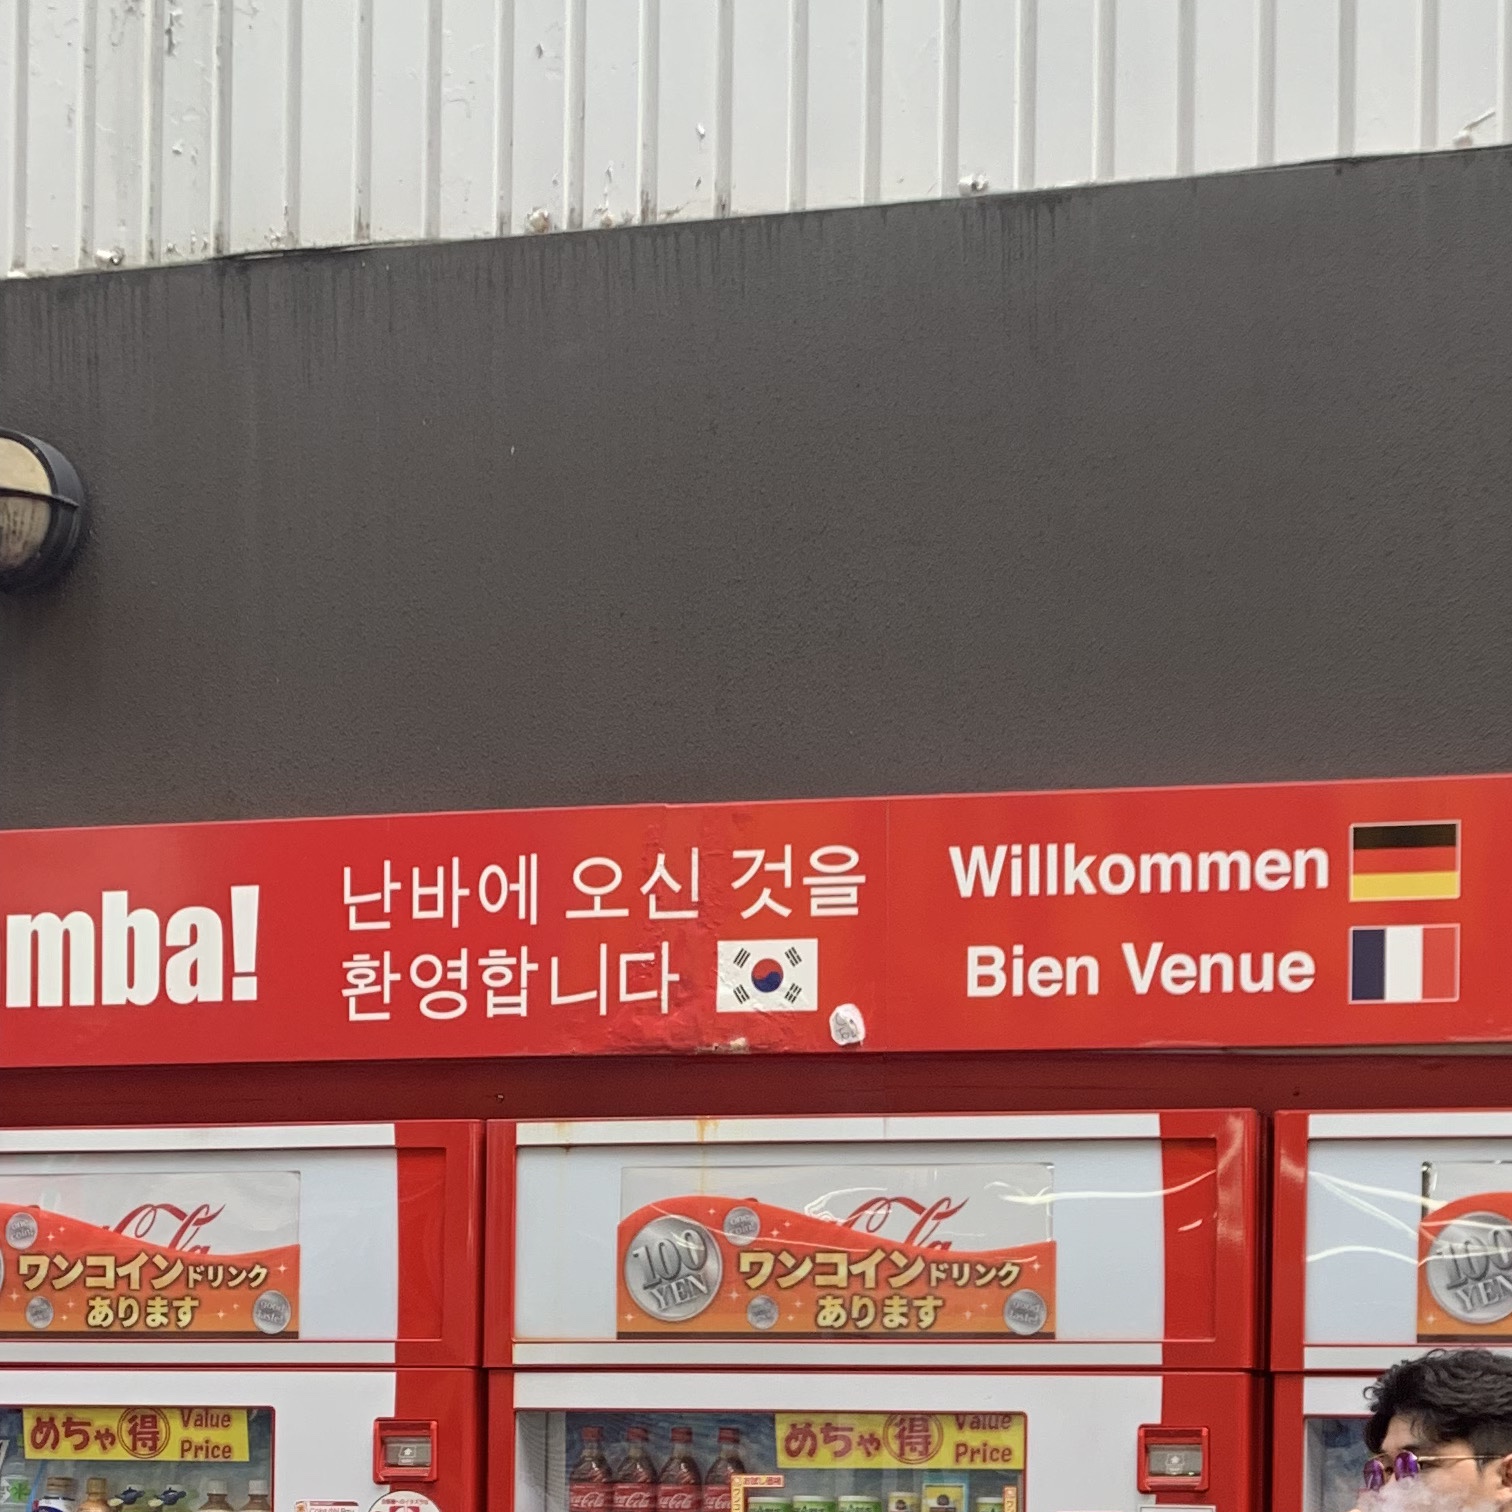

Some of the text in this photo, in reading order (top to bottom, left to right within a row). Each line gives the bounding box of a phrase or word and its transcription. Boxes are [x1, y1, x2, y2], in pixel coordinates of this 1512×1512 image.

[343, 844, 867, 931] 난바에 오신 것을
[948, 842, 1329, 898] Willkommen
[5, 884, 260, 1009] mba!
[341, 940, 680, 1022] 환영합니다
[966, 941, 1316, 998] Bien Venue
[18, 1251, 269, 1291] ワンコインドリンク
[632, 1229, 707, 1290] 100
[739, 1248, 1021, 1289] ワンコインドリンク
[650, 1271, 709, 1311] YEN
[86, 1295, 200, 1329] あります
[816, 1294, 944, 1329] あります
[180, 1408, 232, 1429] Value
[180, 1439, 232, 1460] Price
[954, 1442, 1013, 1464] Price
